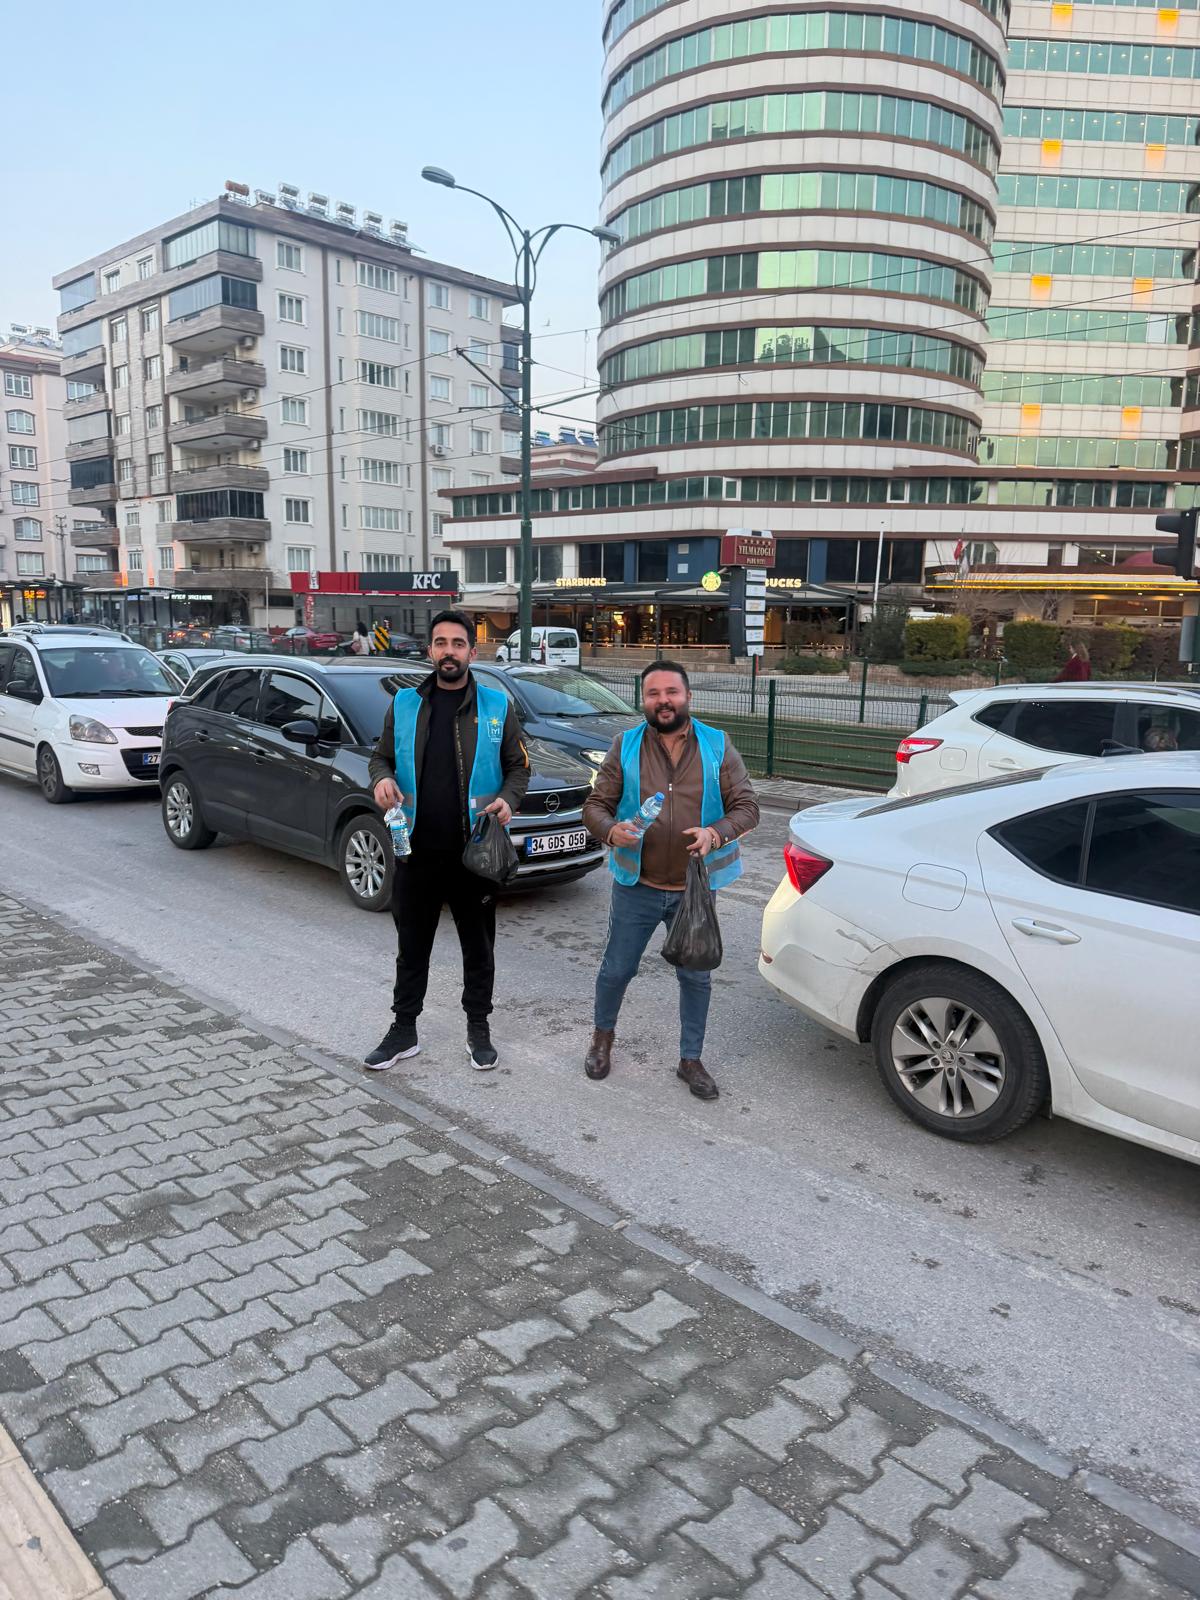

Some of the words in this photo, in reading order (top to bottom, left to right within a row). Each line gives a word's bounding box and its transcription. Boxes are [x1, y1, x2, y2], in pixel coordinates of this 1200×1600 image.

[412, 573, 441, 589] KFC
[556, 577, 606, 587] STARBUCKS
[765, 578, 801, 588] BUCKS
[532, 838, 544, 851] 34
[548, 835, 565, 849] GDS
[569, 833, 584, 846] 058
